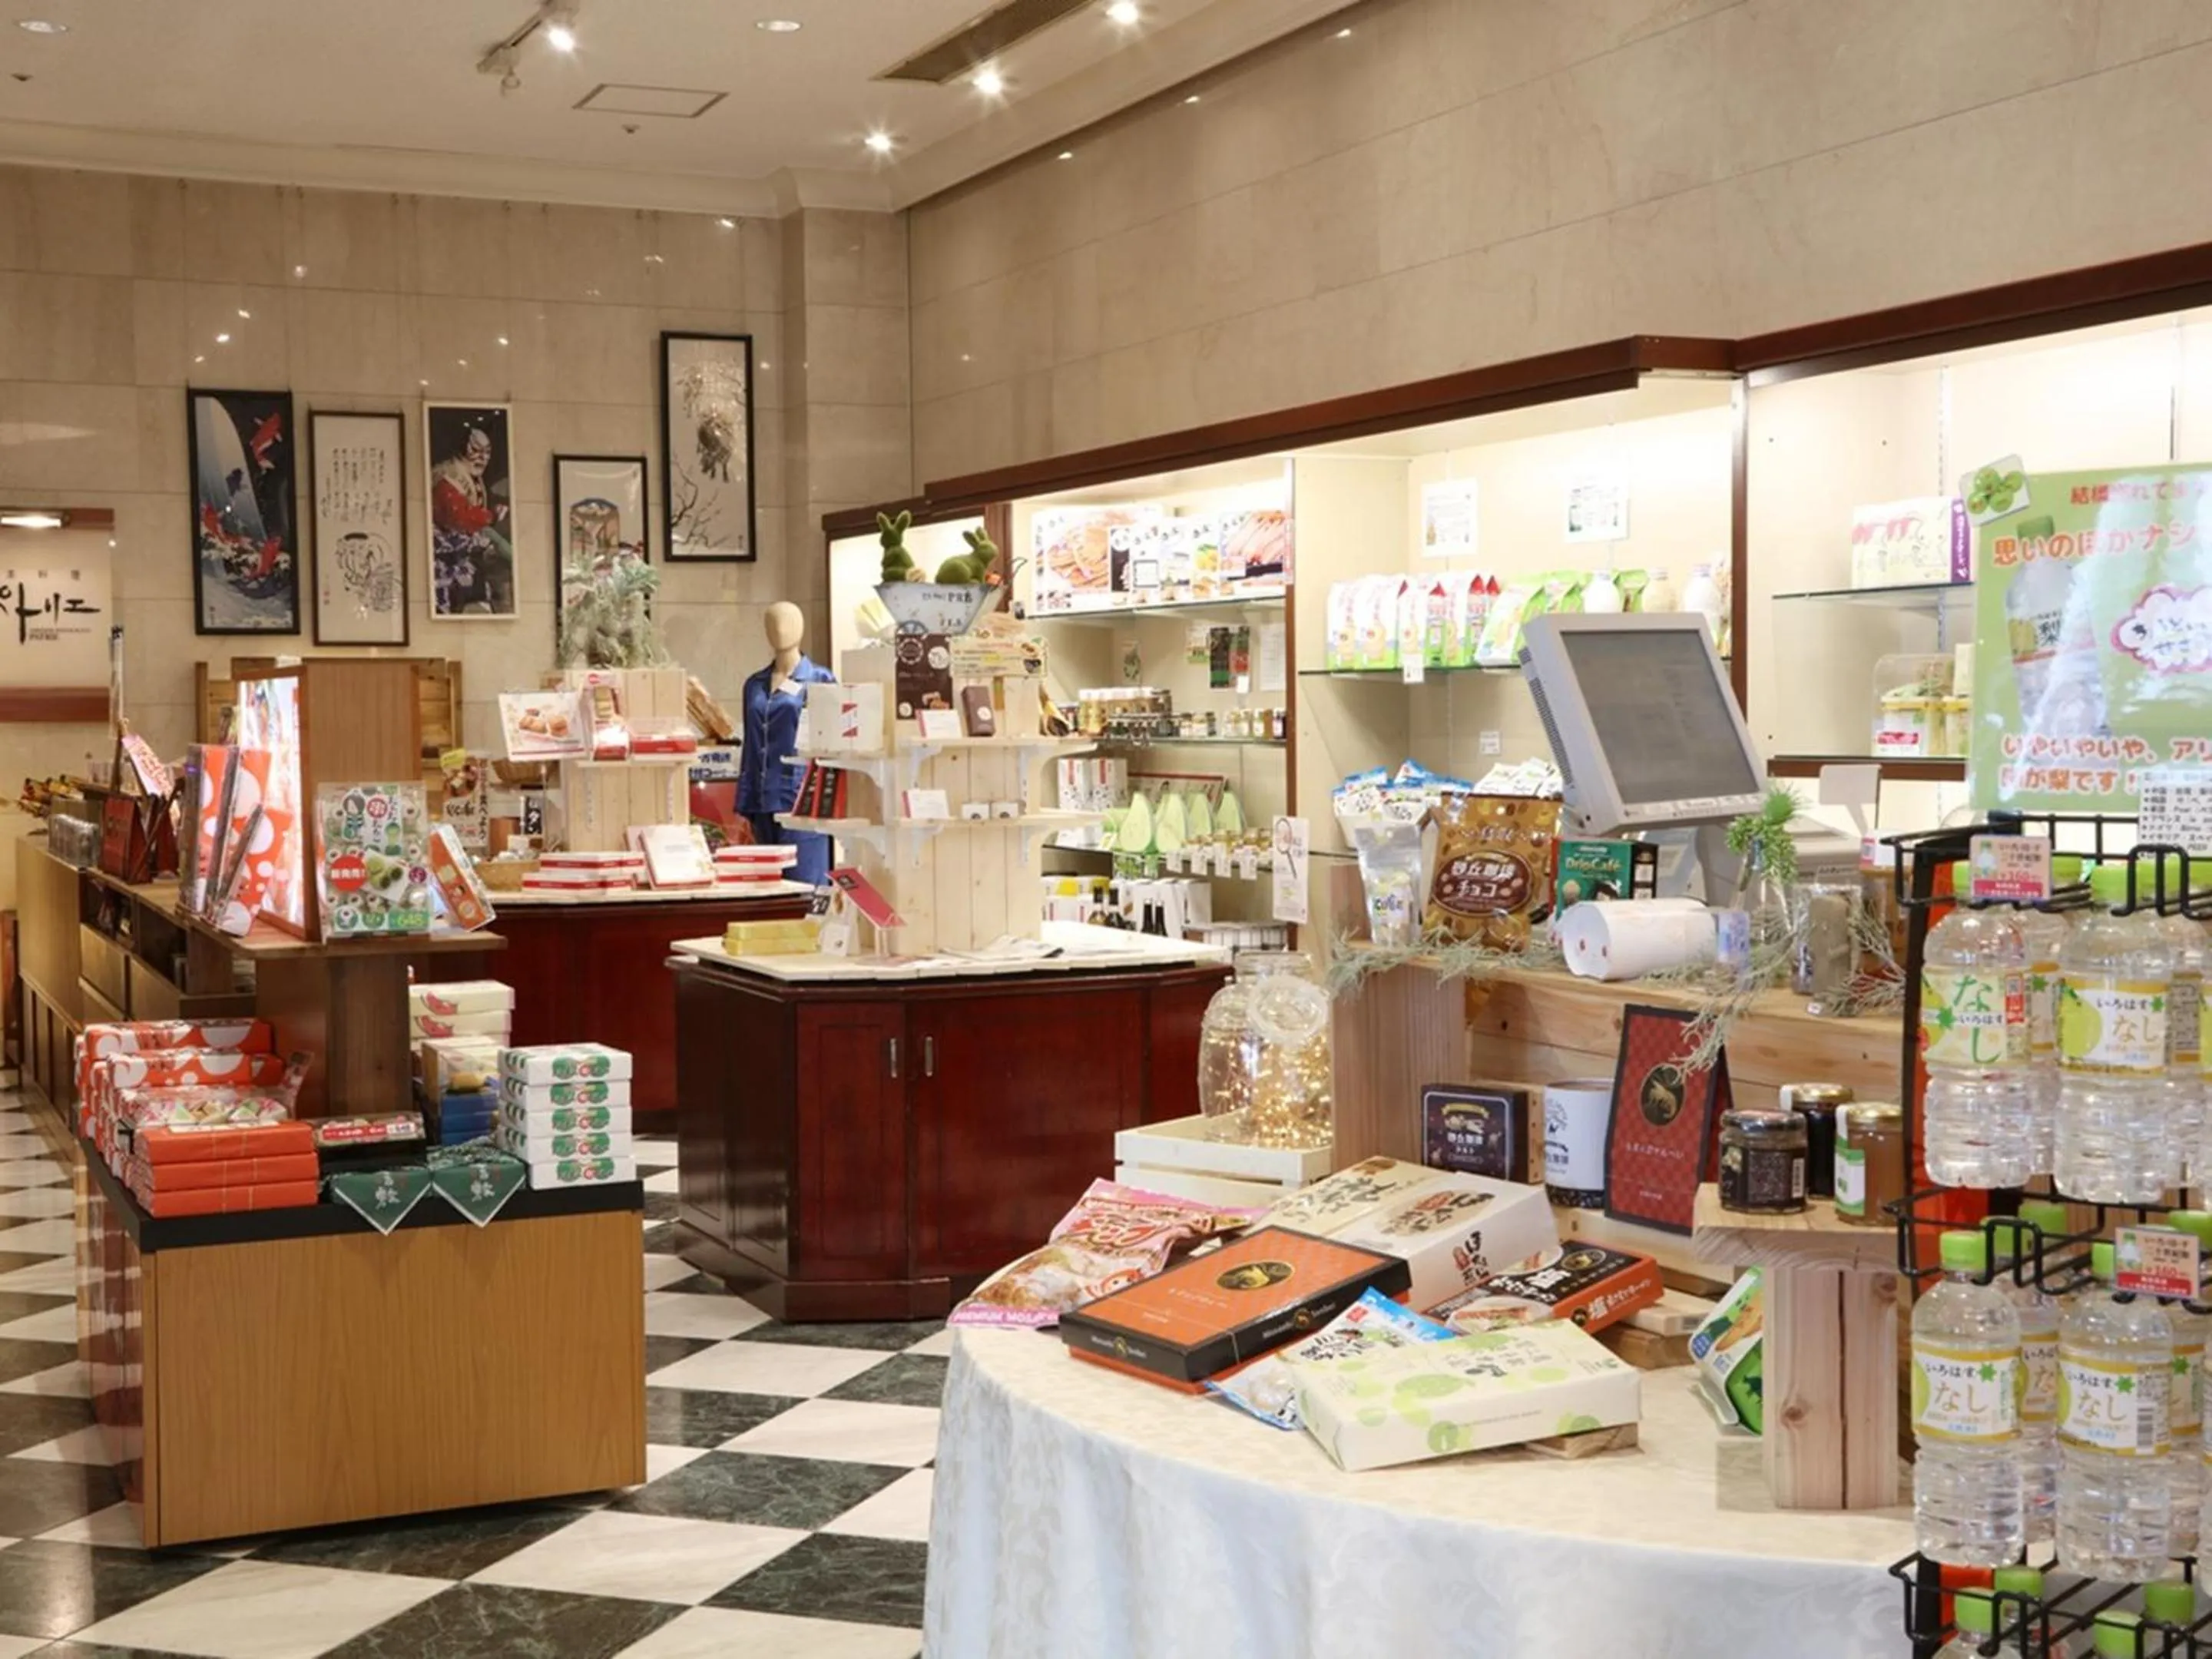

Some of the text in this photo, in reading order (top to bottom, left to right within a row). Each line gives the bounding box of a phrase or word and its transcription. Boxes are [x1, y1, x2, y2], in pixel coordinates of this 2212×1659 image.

[2097, 998, 2149, 1010] いろはす
[2114, 1015, 2161, 1043] なし
[1926, 1363, 1976, 1379] いろはす
[2068, 1373, 2113, 1389] いろはす
[1935, 1381, 1989, 1414] なし
[2078, 1389, 2128, 1422] なし
